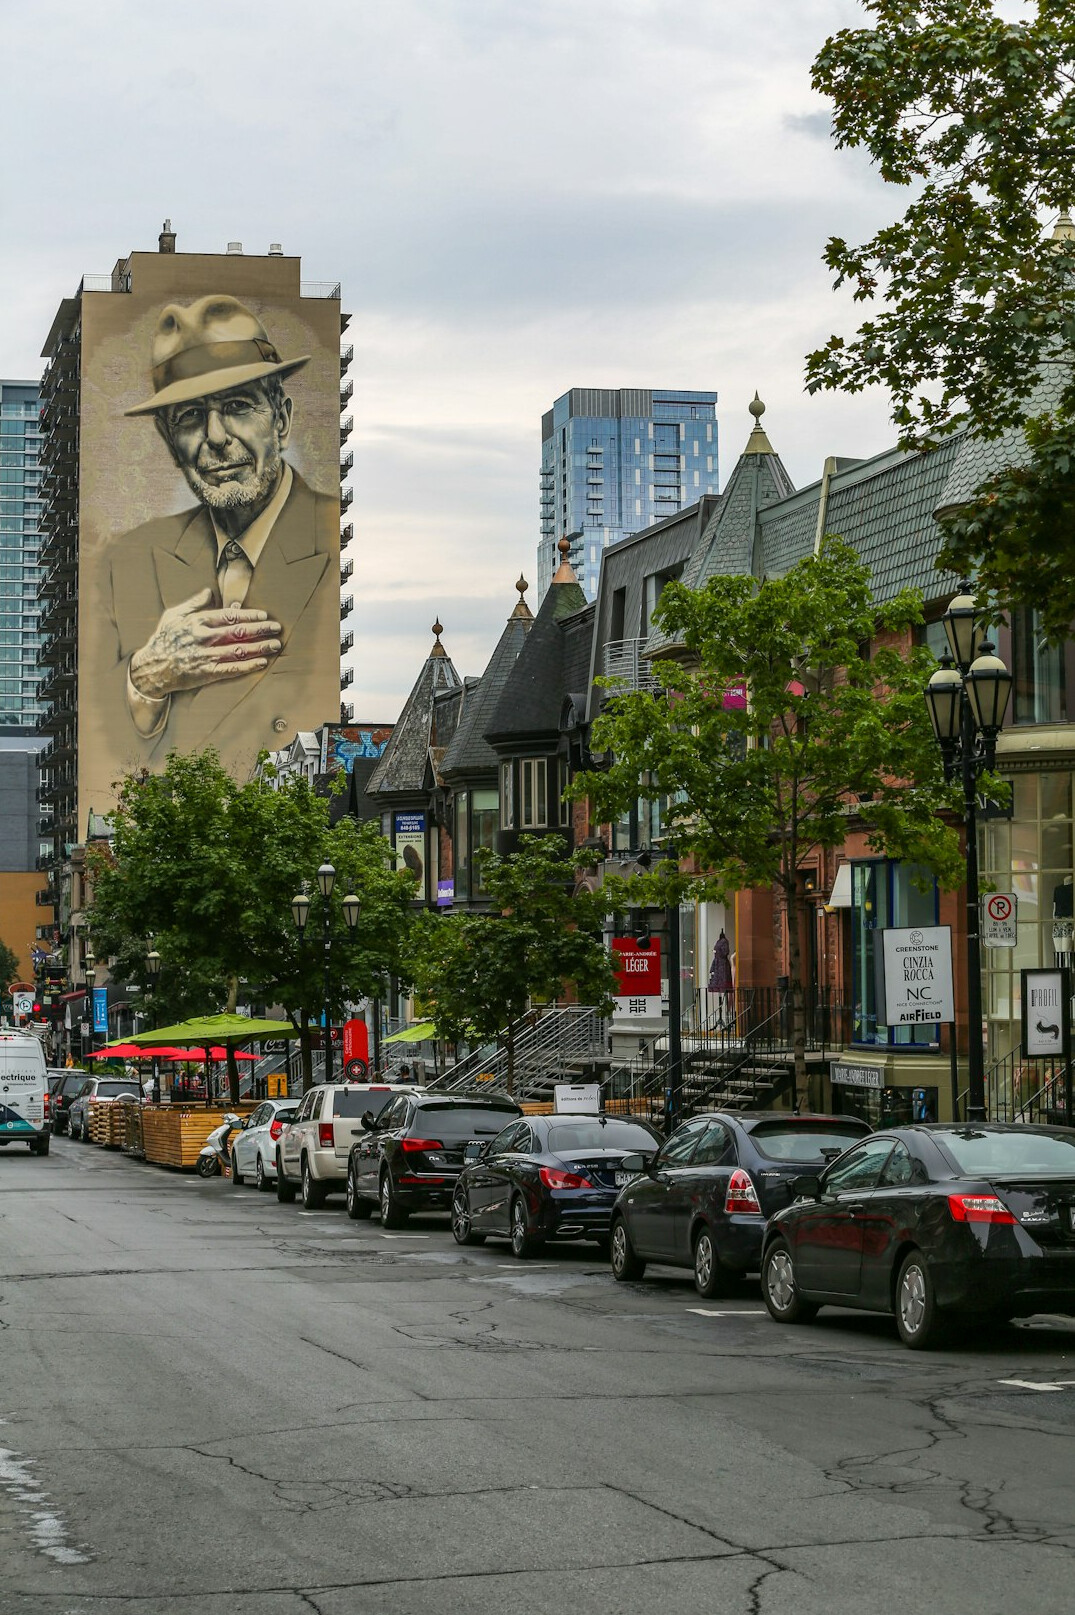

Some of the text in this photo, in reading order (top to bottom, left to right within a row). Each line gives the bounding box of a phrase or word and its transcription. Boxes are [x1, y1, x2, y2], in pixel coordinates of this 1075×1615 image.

[625, 957, 649, 972] LÉGER
[903, 956, 934, 969] CINZIA
[904, 969, 934, 982] ROCCA
[907, 987, 932, 1001] NC
